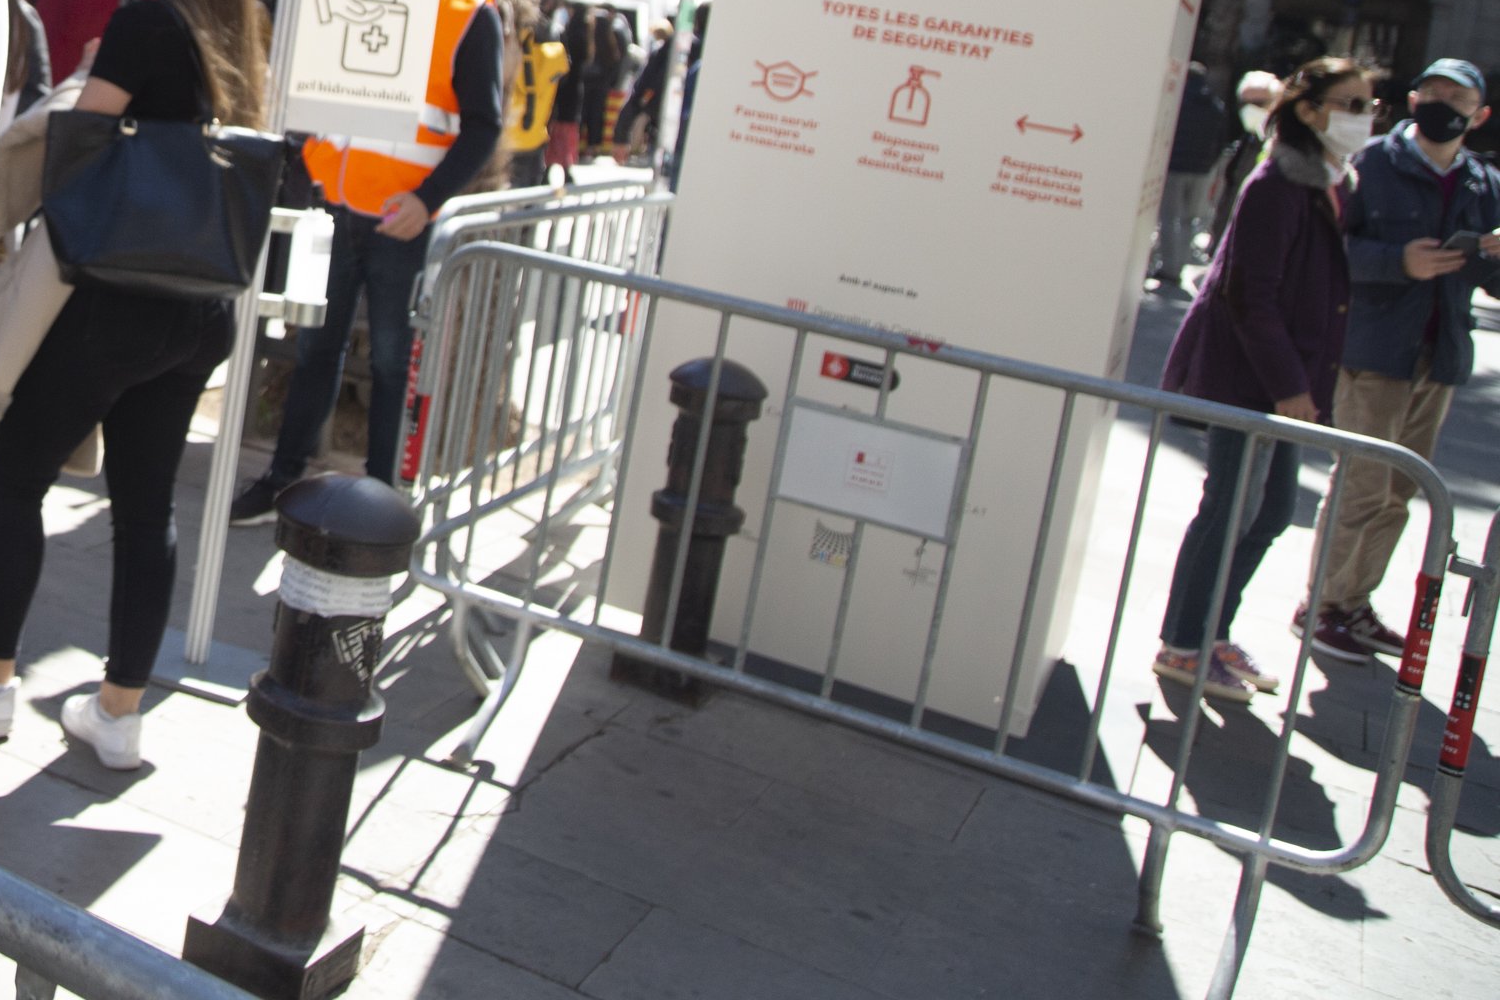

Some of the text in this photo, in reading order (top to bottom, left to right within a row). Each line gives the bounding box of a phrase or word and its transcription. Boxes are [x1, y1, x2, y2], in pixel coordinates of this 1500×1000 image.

[822, 0, 1034, 47] TOTES LES GARANTIES
[853, 25, 993, 59] DE SEGURETAT
